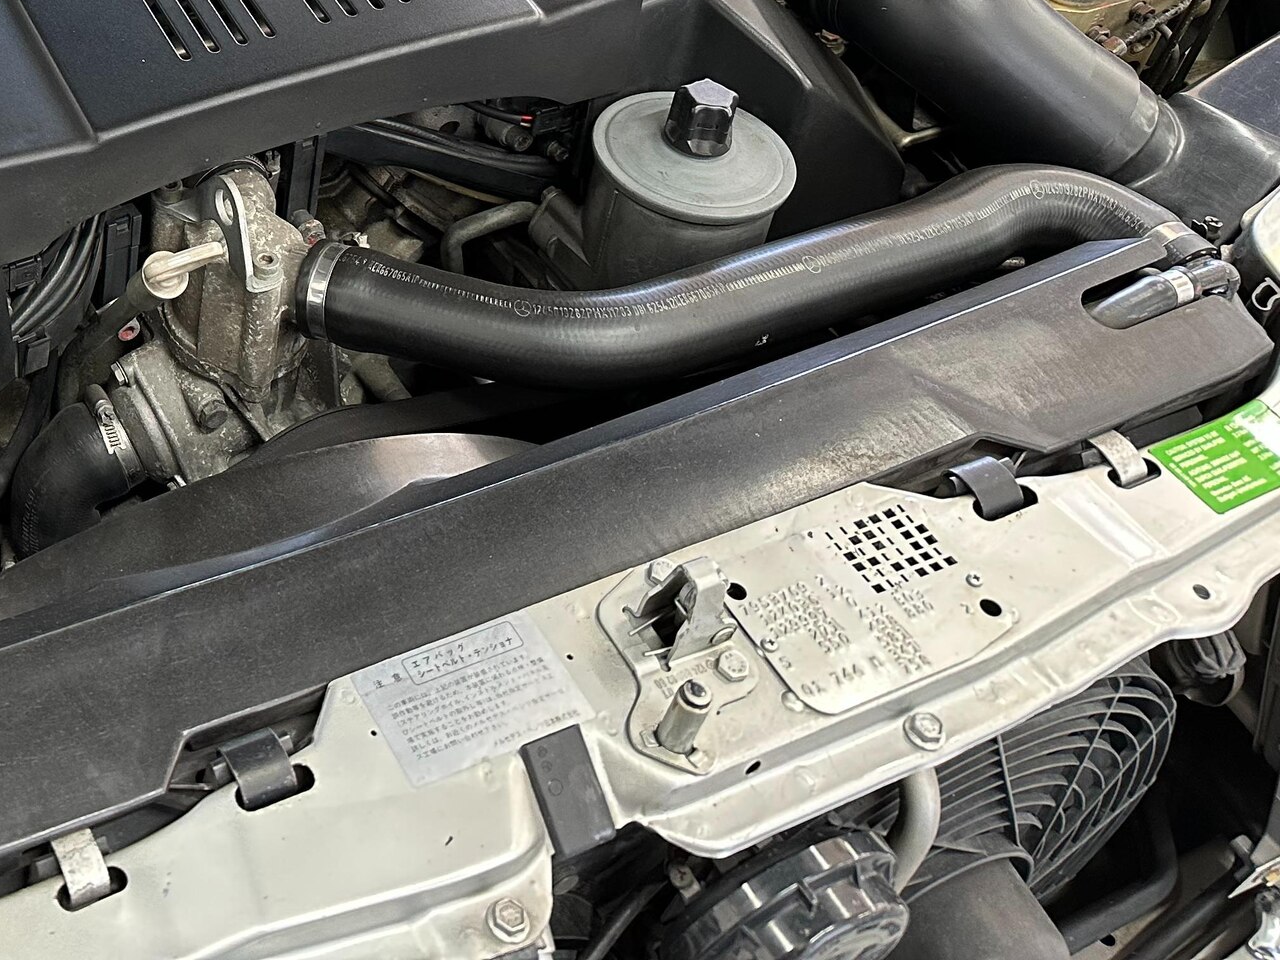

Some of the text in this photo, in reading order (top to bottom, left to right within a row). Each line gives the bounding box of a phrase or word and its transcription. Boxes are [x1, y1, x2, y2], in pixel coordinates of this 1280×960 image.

[411, 642, 466, 668] エアバッグ
[416, 635, 514, 678] シートベルト・テンショナ
